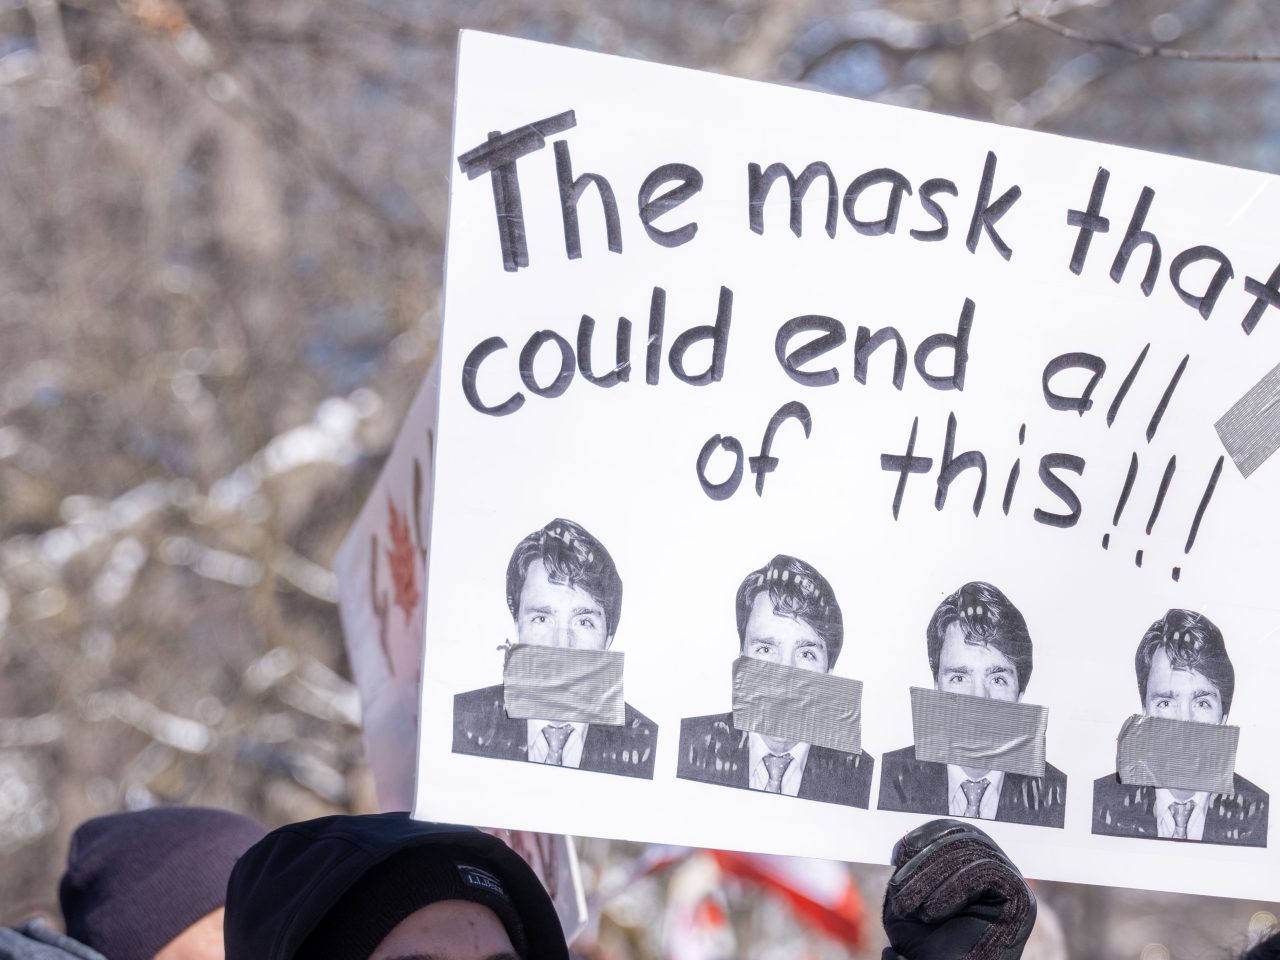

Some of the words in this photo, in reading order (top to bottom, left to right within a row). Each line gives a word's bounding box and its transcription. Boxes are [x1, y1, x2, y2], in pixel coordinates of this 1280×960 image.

[458, 110, 703, 272] The
[748, 150, 1021, 262] mask
[462, 286, 733, 417] could
[775, 297, 975, 392] end
[1043, 341, 1189, 443] all
[697, 401, 811, 501] of
[880, 412, 1225, 582] this!!!
